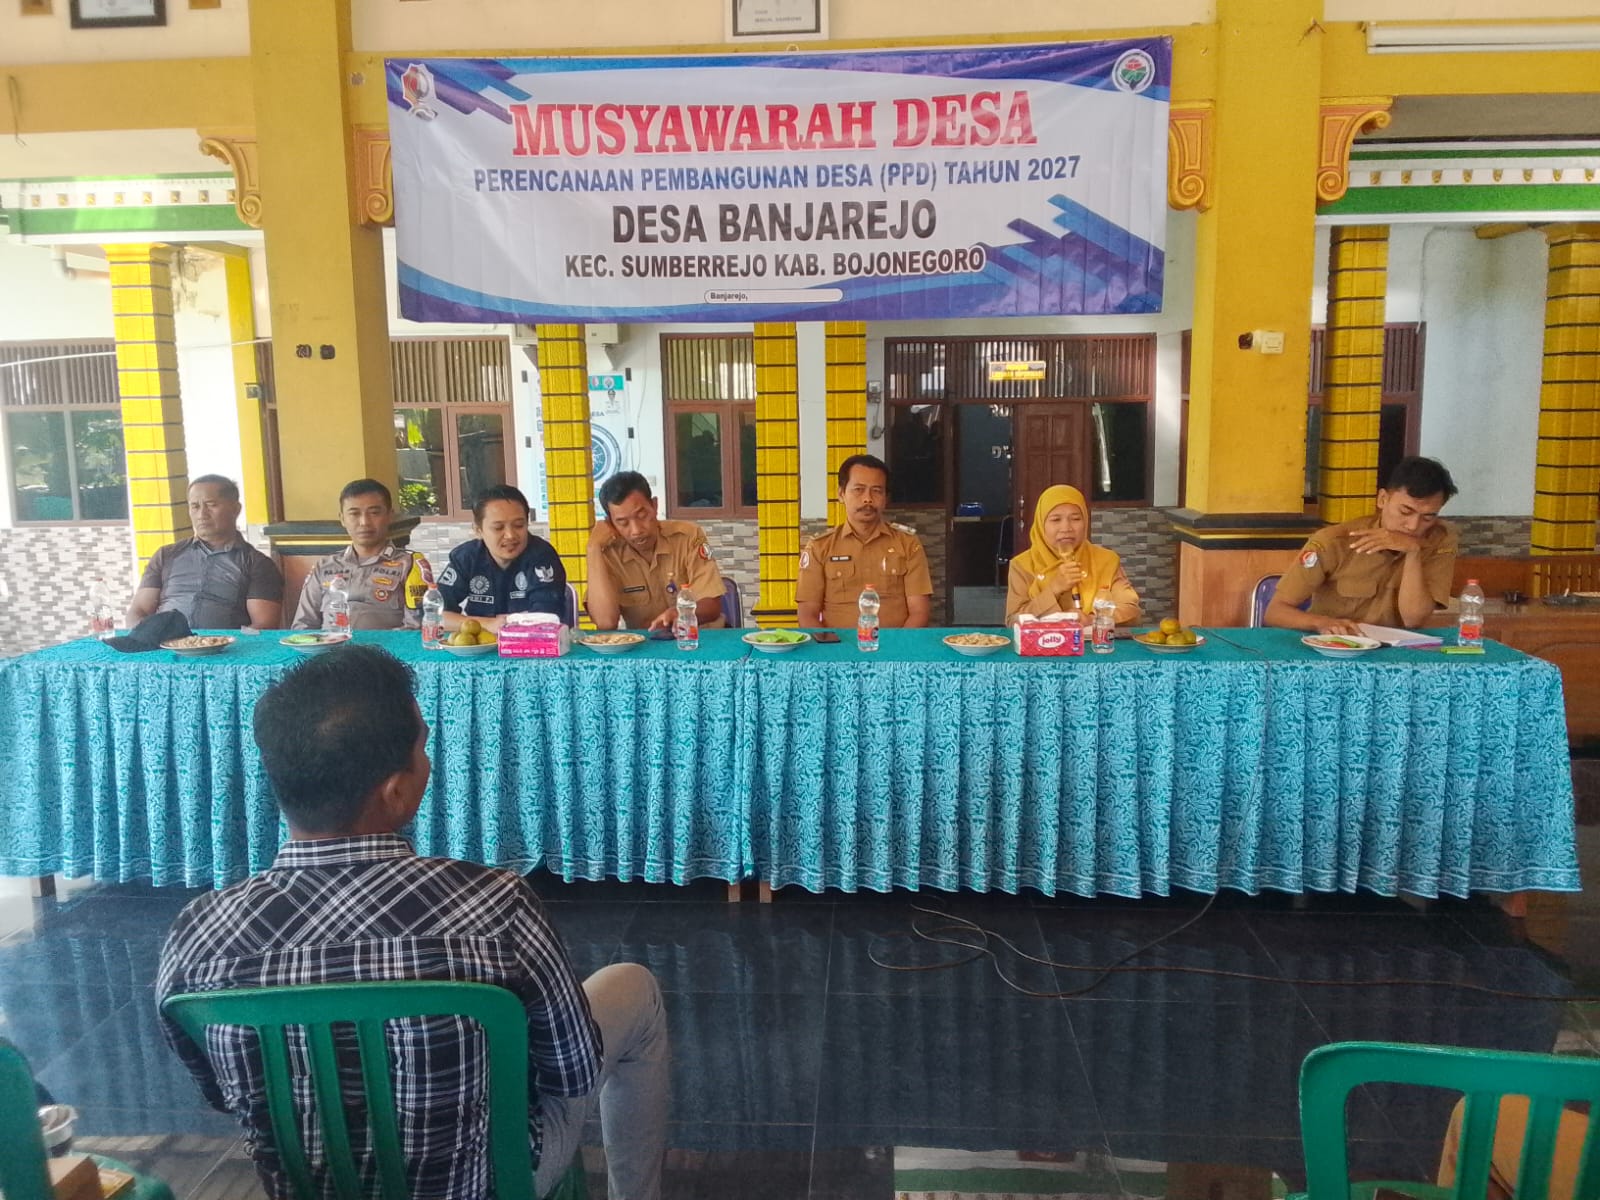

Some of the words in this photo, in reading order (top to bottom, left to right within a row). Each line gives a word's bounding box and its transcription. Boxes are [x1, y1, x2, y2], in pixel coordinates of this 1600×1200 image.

[509, 101, 877, 156] MUSYAWARAH
[892, 89, 1038, 149] DESA
[474, 168, 635, 192] PERENCANAAN
[641, 164, 809, 191] PEMBANGUNAN
[816, 163, 873, 188] DESA
[880, 161, 937, 192] (PPD)
[944, 158, 1021, 185] TAHUN
[1027, 155, 1081, 180] 2027
[612, 204, 707, 244] DESA
[719, 199, 937, 243] BANJAREJO
[565, 254, 615, 278] KEC.
[621, 253, 767, 278] SUMBERREJO
[775, 252, 826, 276] KAB.
[833, 246, 986, 276] BOJONEGORO
[710, 292, 748, 301] Banjarejo,
